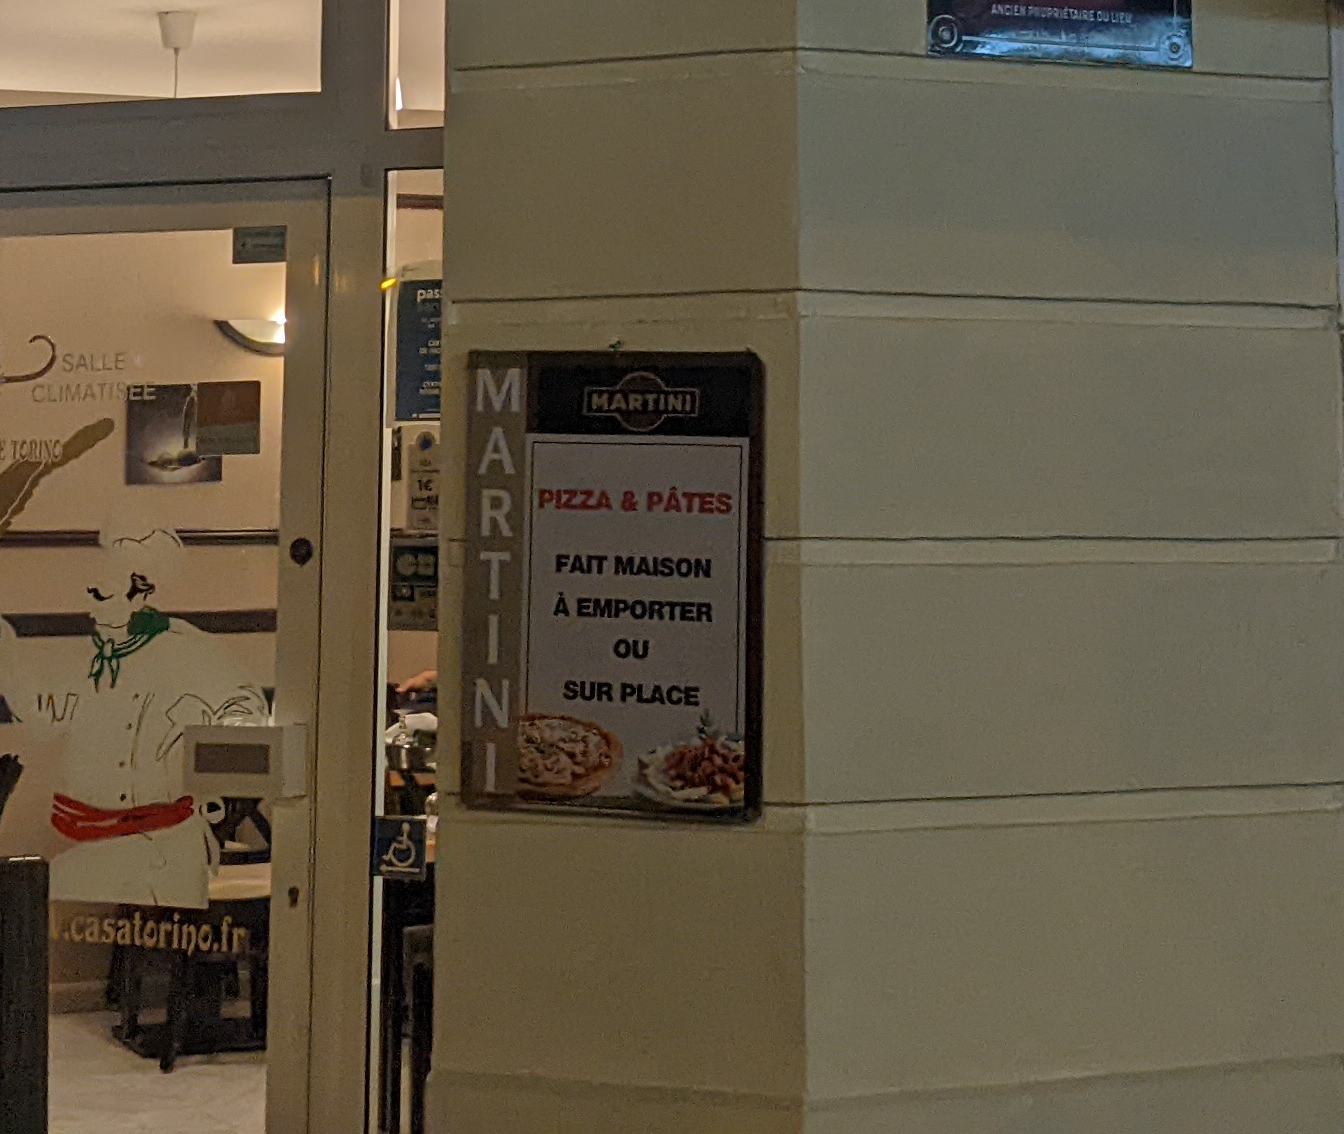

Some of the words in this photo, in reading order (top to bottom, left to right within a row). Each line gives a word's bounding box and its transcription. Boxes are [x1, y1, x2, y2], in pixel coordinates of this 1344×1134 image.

[990, 3, 1026, 17] ANCIEN
[1096, 9, 1110, 22] DU
[62, 353, 128, 372] SALLE
[591, 392, 692, 412] MARTINI
[11, 438, 63, 461] TORINO
[538, 488, 613, 511] PIZZA
[620, 490, 638, 512] &
[647, 485, 734, 514] PÂTES
[555, 553, 608, 576] FAIT
[614, 555, 712, 579] MAISON
[471, 367, 522, 793] MARTINI
[553, 592, 570, 618] À
[576, 599, 713, 623] EMPORTER
[613, 639, 649, 659] OU
[563, 680, 613, 703] SUR
[620, 683, 701, 707] PLACE
